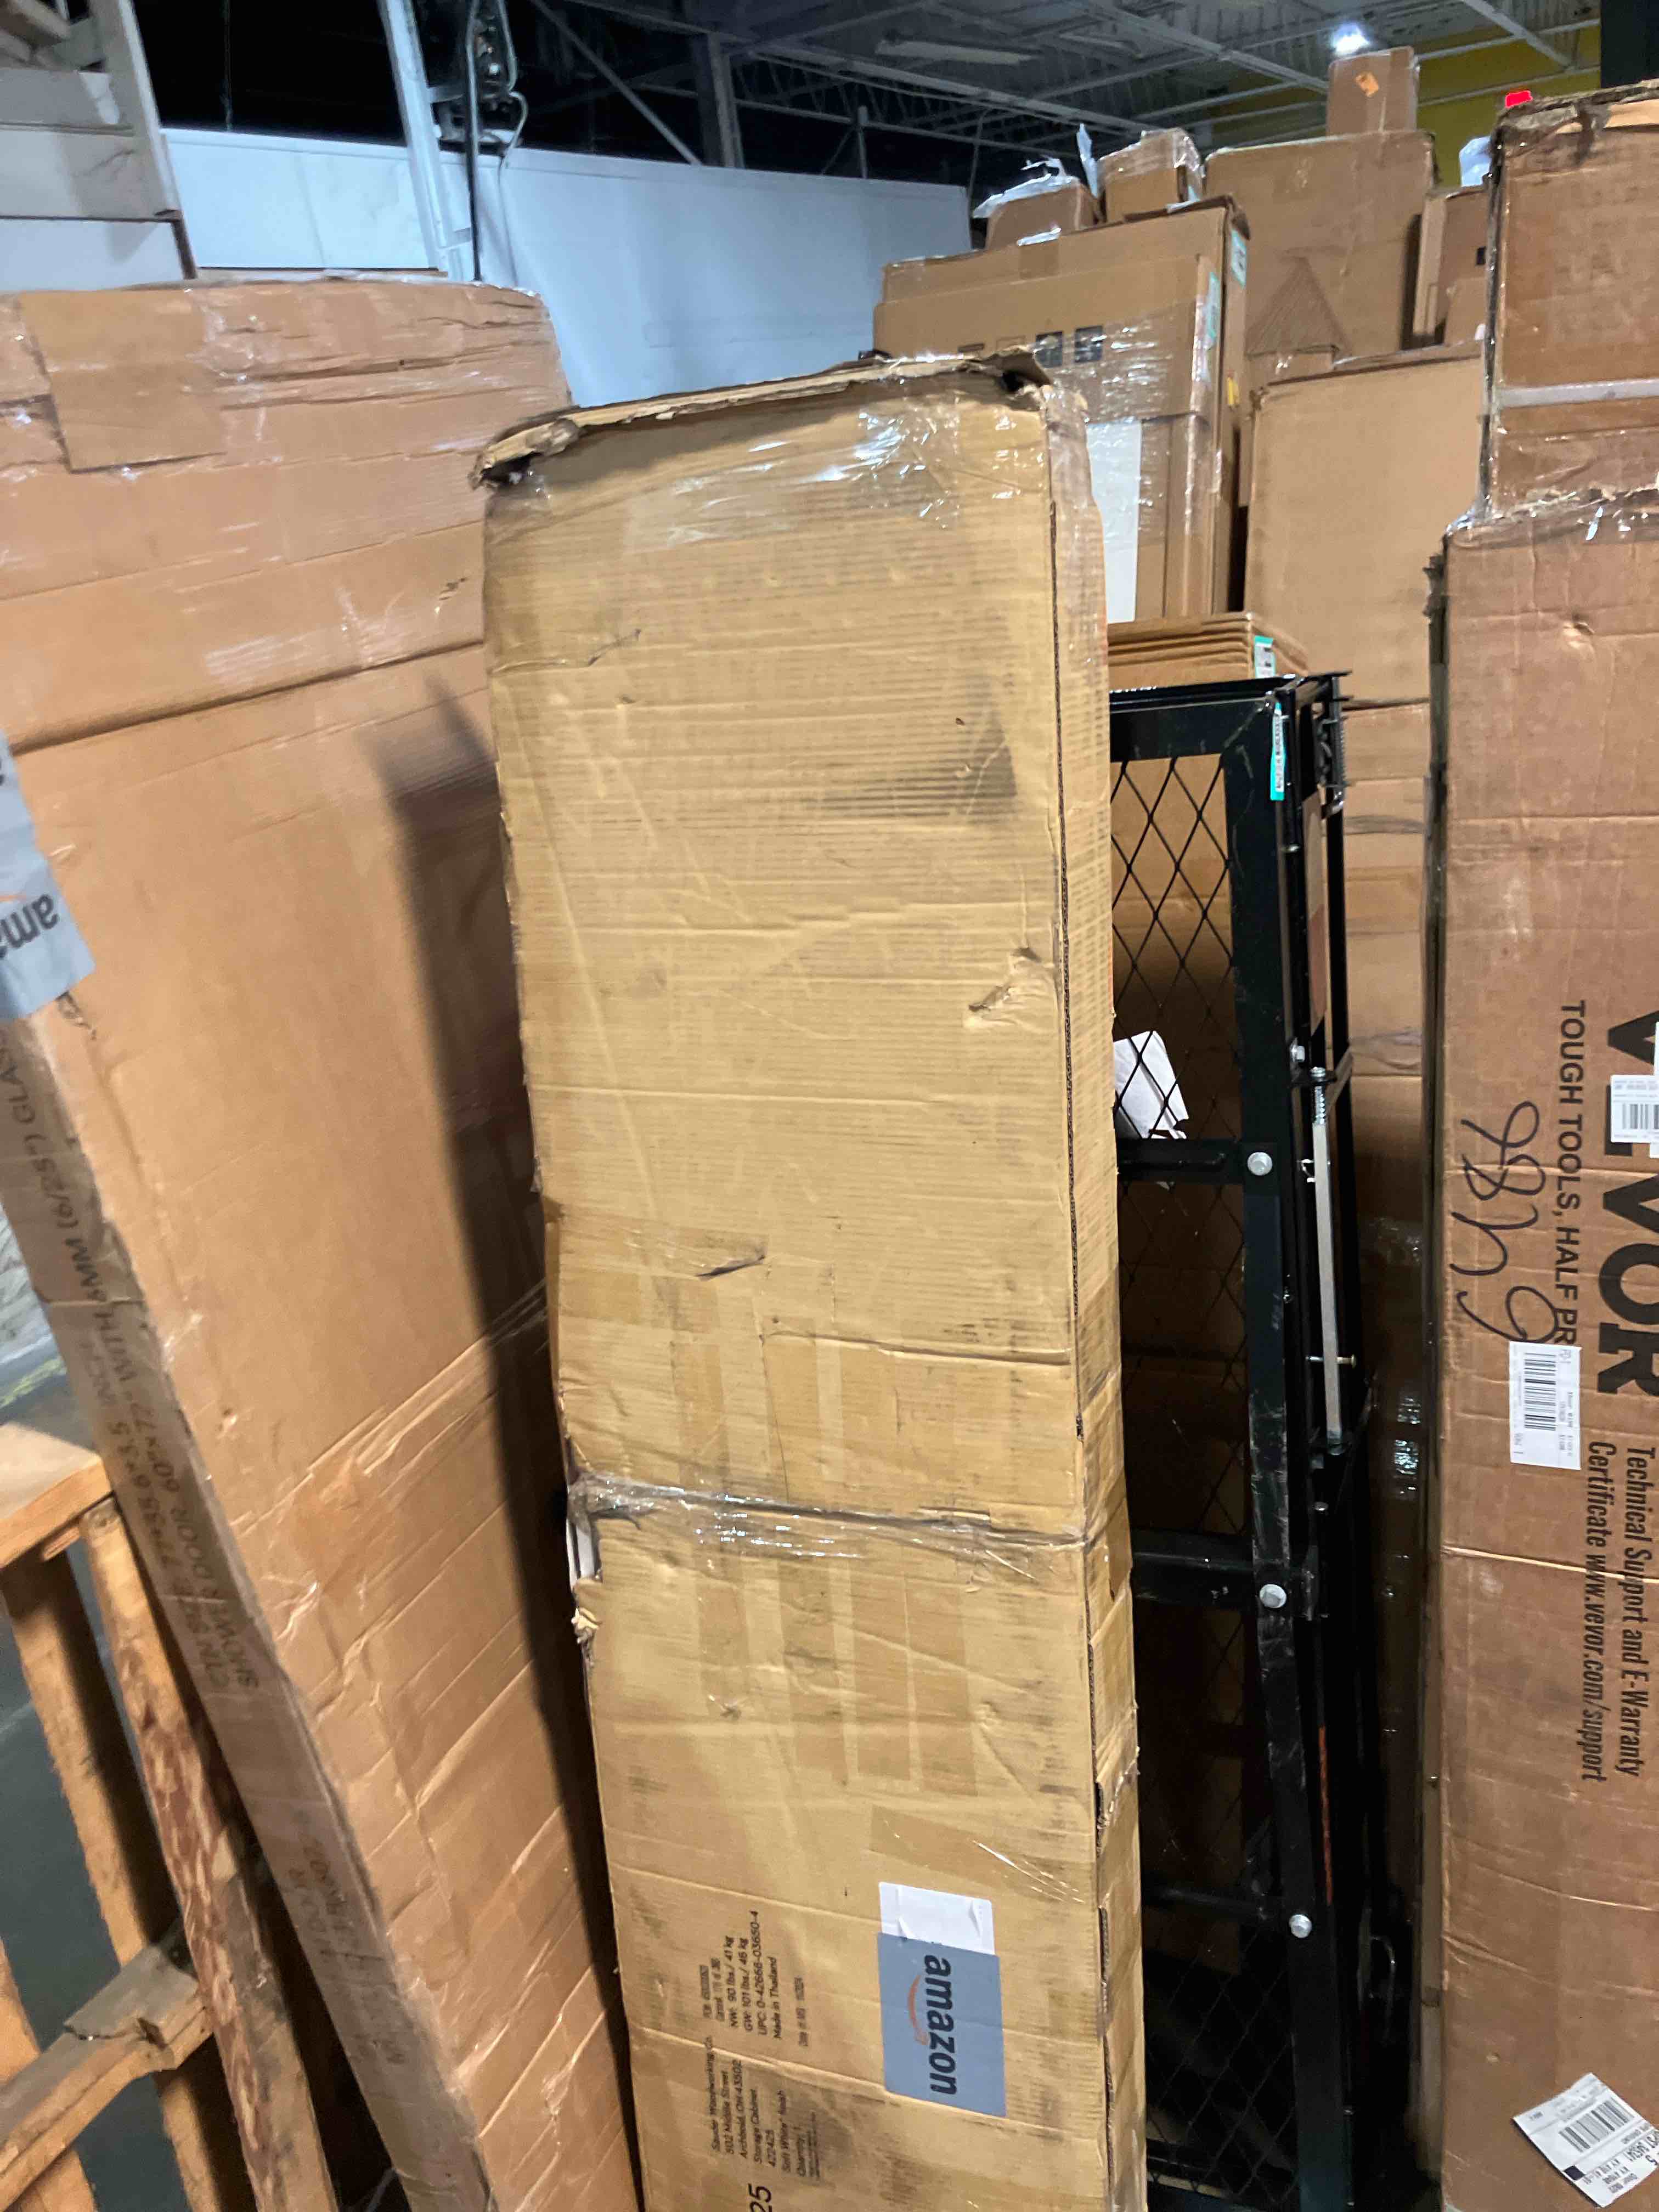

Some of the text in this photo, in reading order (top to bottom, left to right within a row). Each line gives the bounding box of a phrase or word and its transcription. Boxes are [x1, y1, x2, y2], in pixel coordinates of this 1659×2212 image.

[0, 894, 60, 958] am
[1559, 1000, 1585, 1104] TOUGH
[1553, 1114, 1583, 1216] TOOLS,
[1555, 1228, 1579, 1301] HALF
[1554, 1309, 1577, 1344] PR
[1576, 1441, 1617, 1781] Certificate www.vevor.com/support
[1615, 1448, 1655, 1776] Technical Support and E-Warranty
[768, 1956, 781, 2039] Made in Thailand
[924, 1955, 957, 2095] amazon
[754, 2128, 763, 2164] Storage
